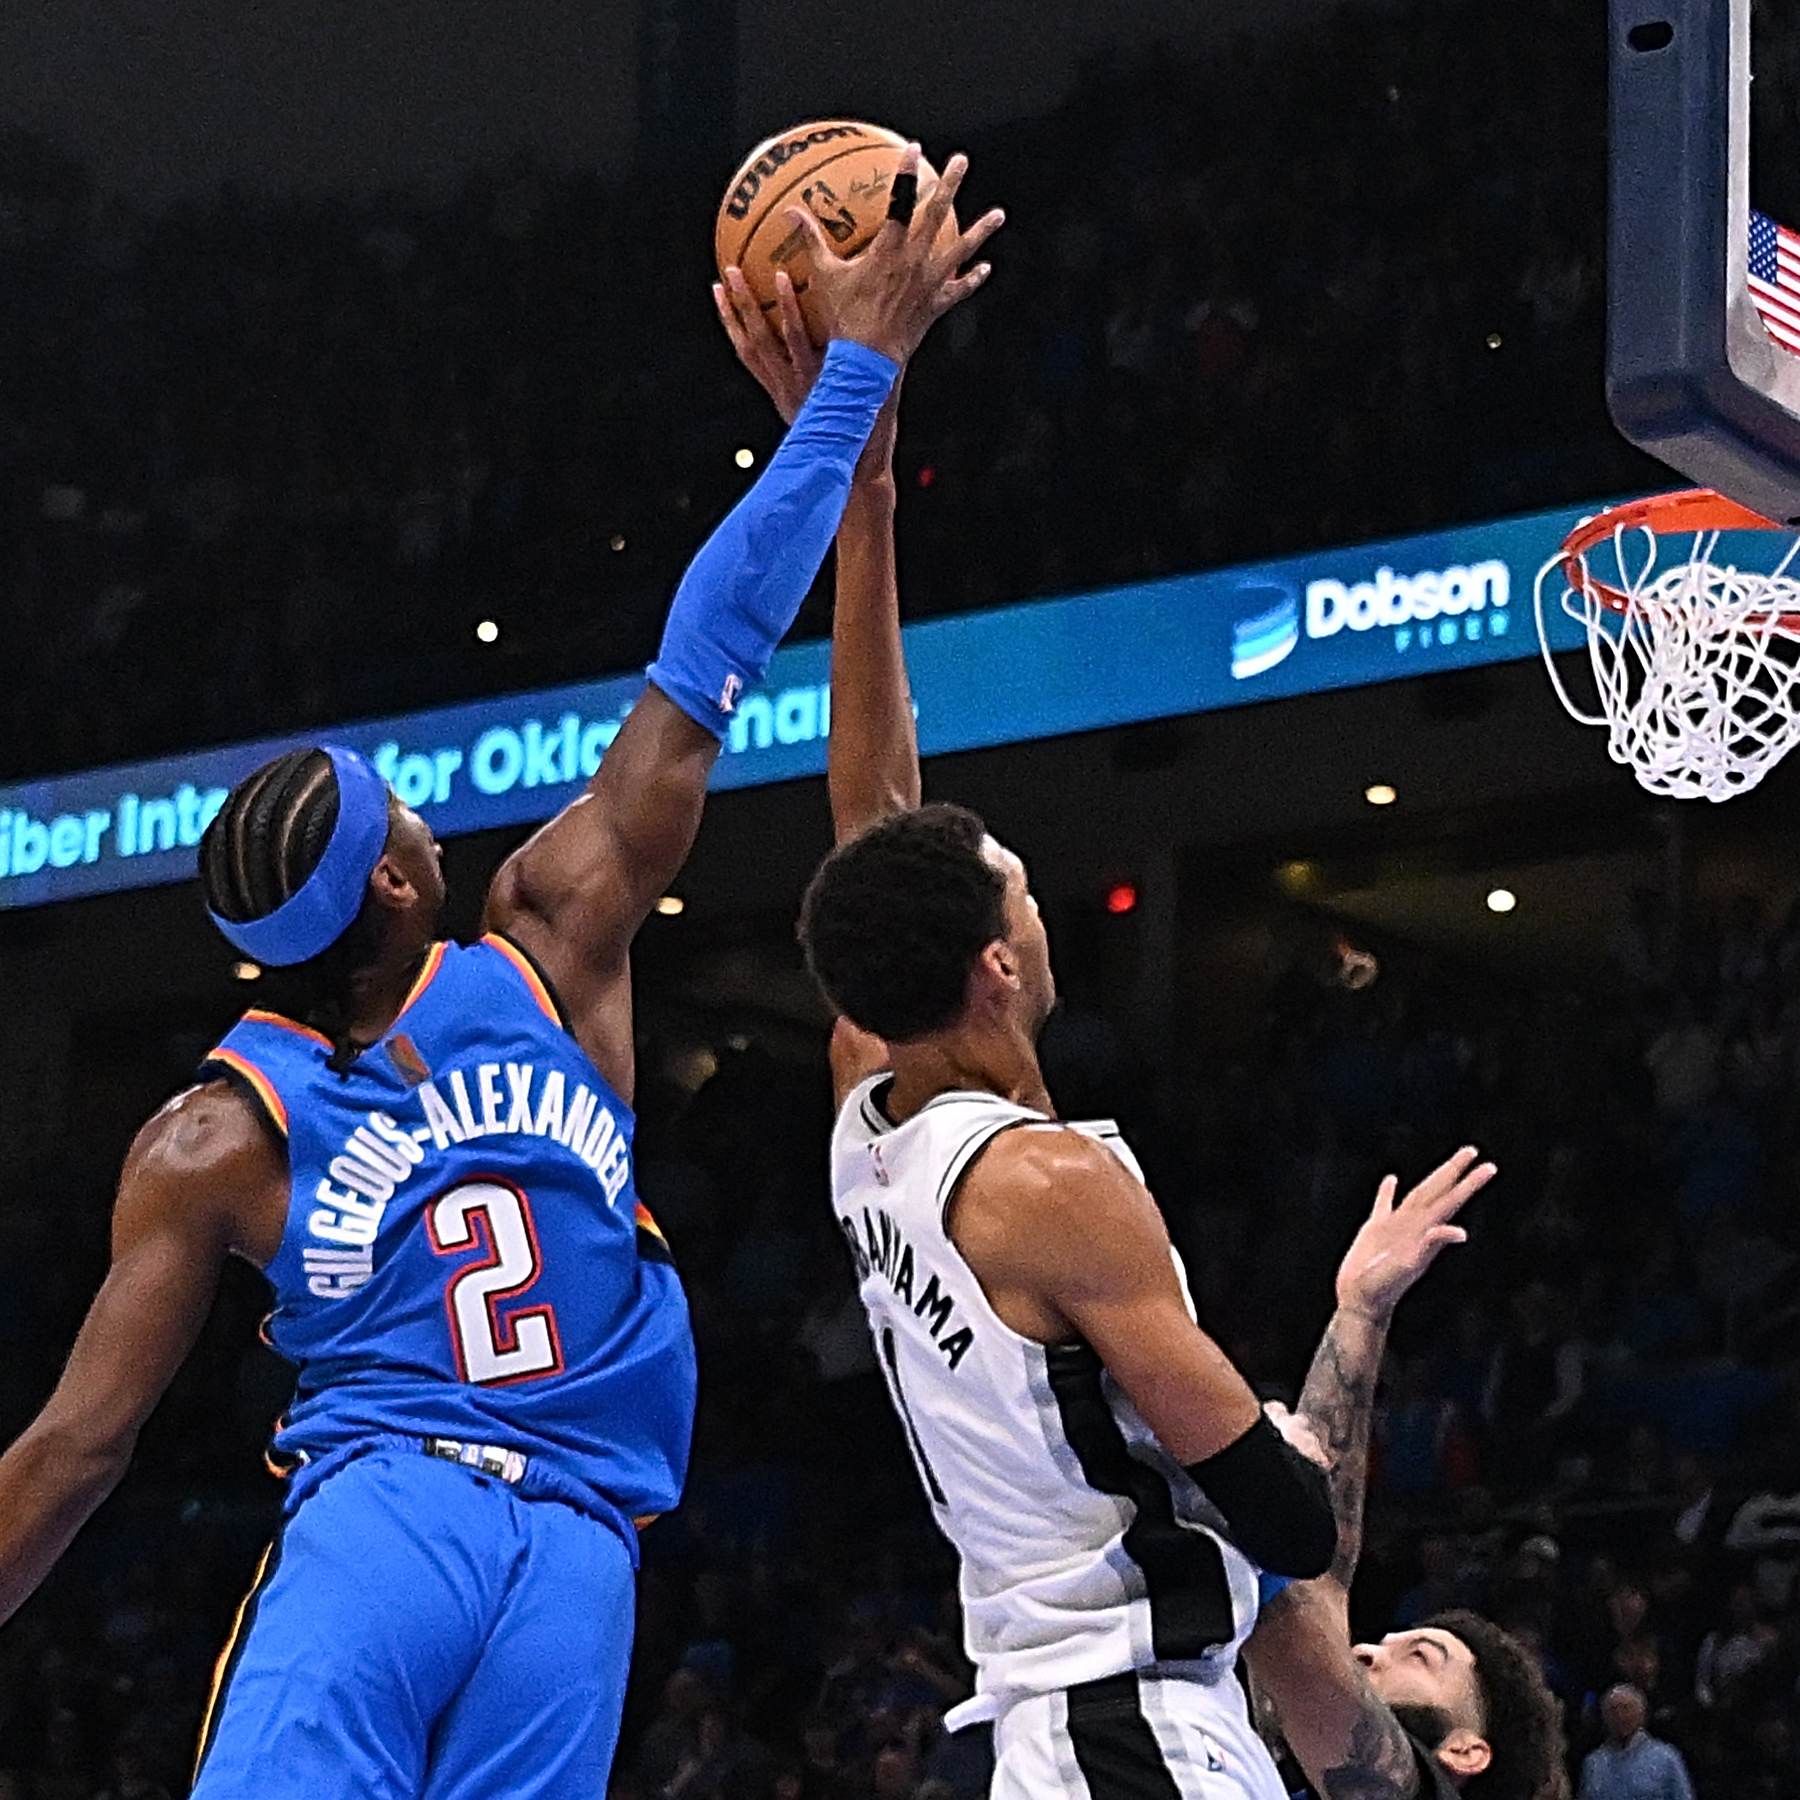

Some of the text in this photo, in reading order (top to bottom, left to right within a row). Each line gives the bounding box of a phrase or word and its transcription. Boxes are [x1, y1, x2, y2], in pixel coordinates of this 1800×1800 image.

[1305, 559, 1510, 639] Dobson
[303, 1062, 632, 1300] GILGEOUS-ALEXANDER
[425, 1172, 565, 1388] 2
